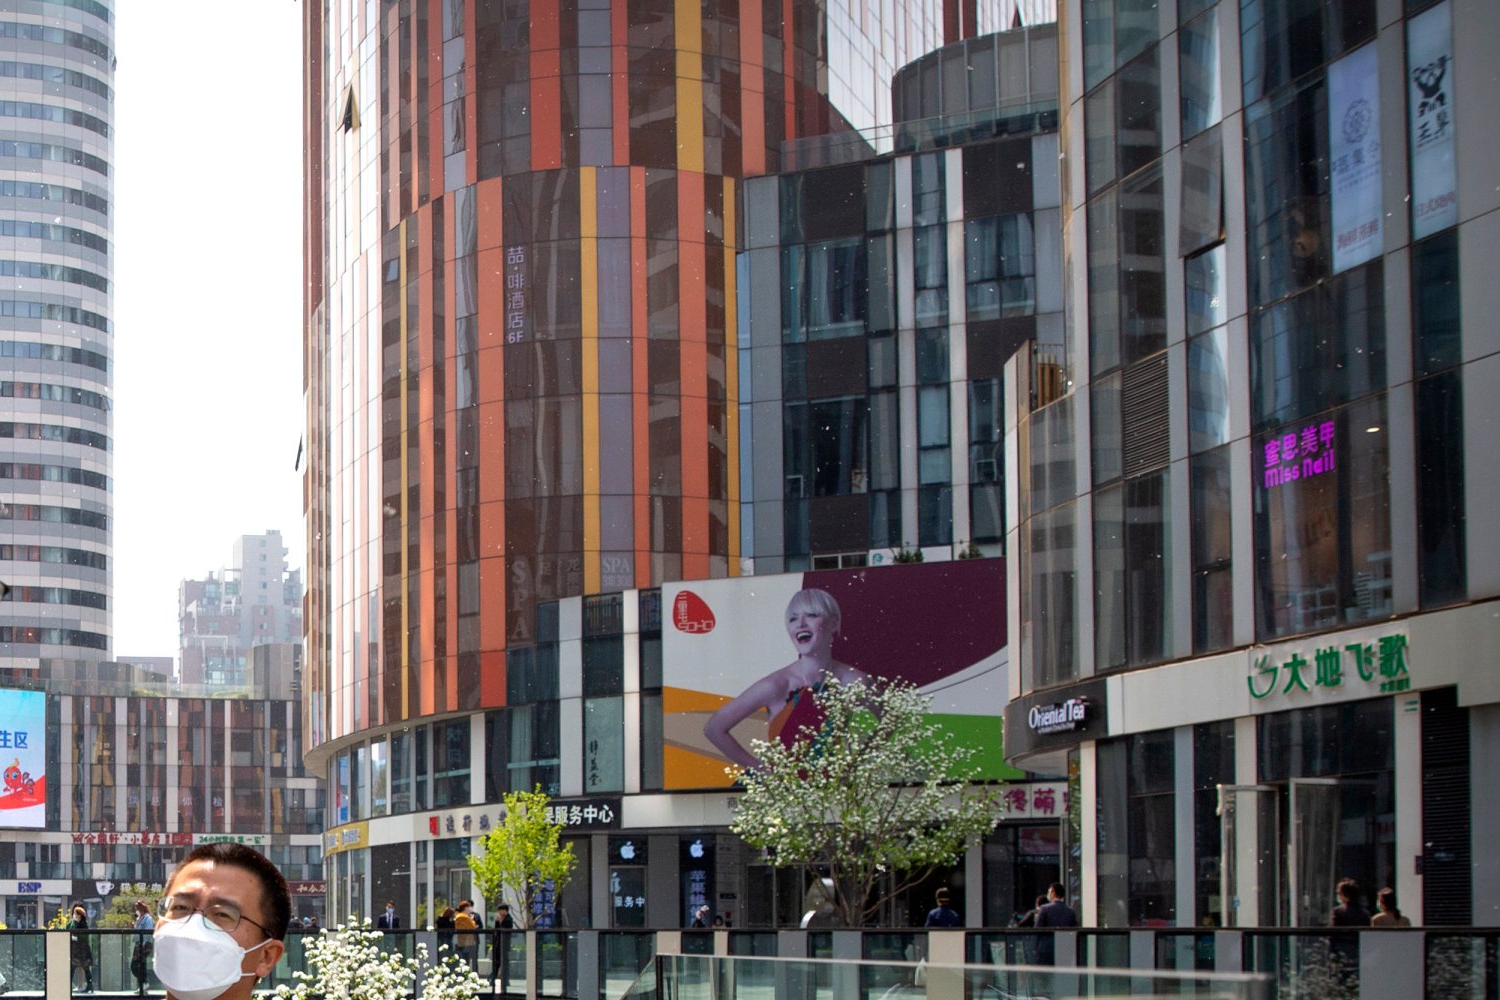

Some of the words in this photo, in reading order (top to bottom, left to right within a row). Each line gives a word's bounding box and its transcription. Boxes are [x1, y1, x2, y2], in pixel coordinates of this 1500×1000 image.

[508, 331, 524, 344] 6F
[1264, 464, 1300, 489] miss
[603, 558, 630, 573] SPA
[1283, 634, 1409, 694] 大地飞歌
[1028, 703, 1067, 729] Oriental
[1067, 699, 1085, 720] Tea
